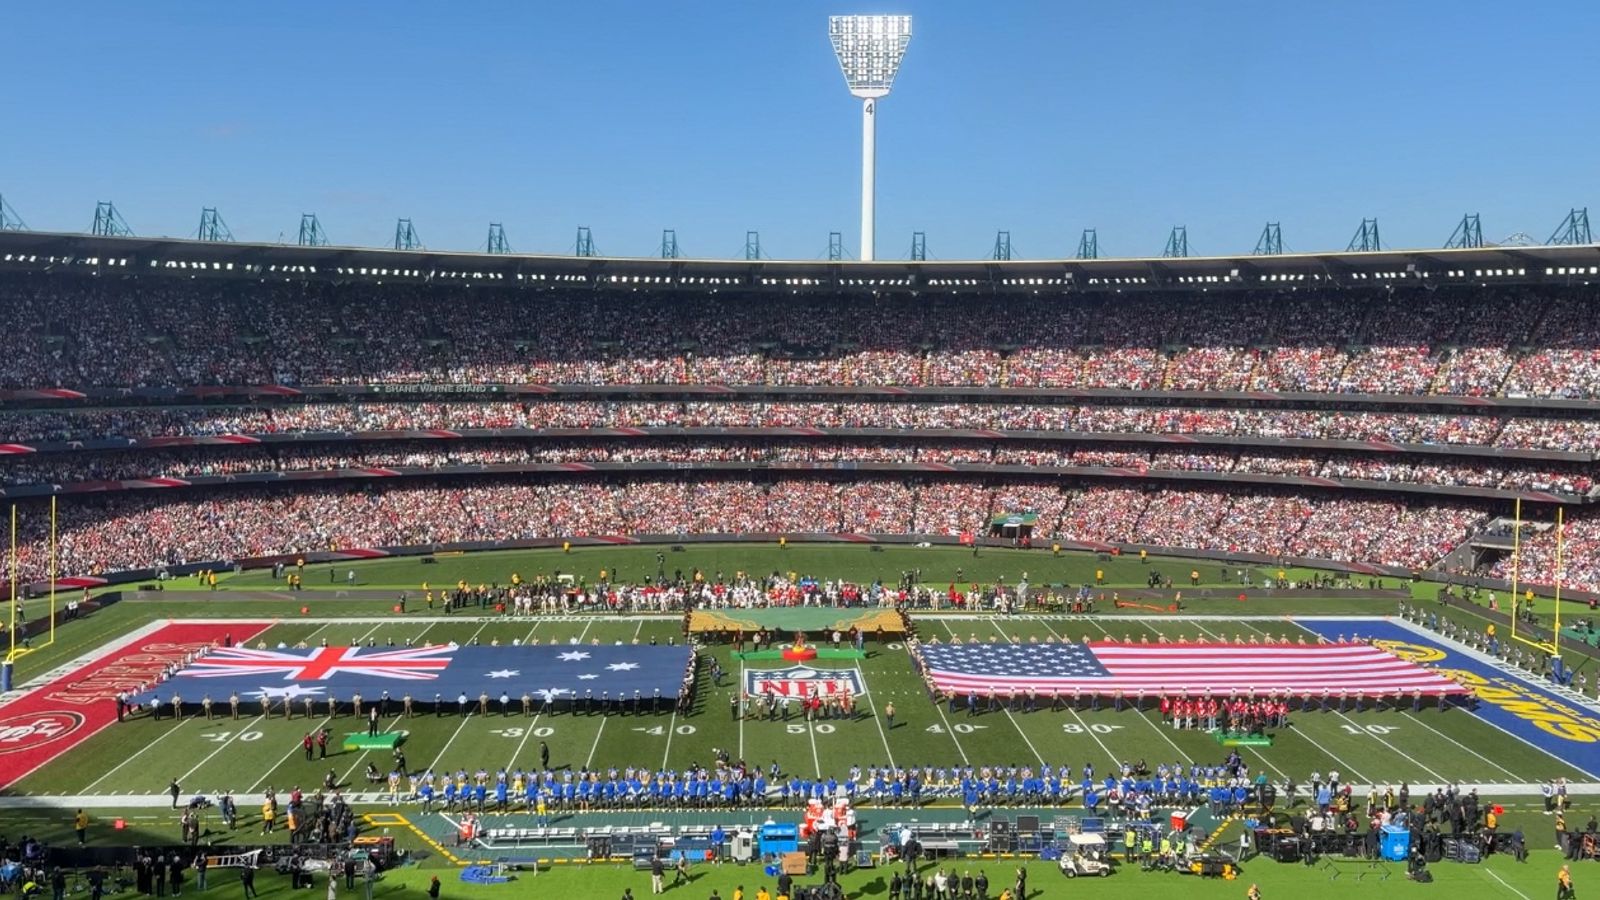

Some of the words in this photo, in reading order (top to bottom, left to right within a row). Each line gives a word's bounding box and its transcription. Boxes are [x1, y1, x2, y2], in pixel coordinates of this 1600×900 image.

[865, 103, 874, 115] 4
[385, 384, 417, 393] SHANE
[420, 384, 454, 393] WARNE
[456, 384, 486, 393] STAND
[759, 680, 851, 697] NFL
[501, 727, 555, 737] 30
[646, 724, 697, 735] 40
[786, 724, 836, 734] 50
[925, 723, 975, 733] 40
[1062, 723, 1113, 733] 30
[1340, 724, 1391, 734] 10
[208, 731, 264, 742] 10
